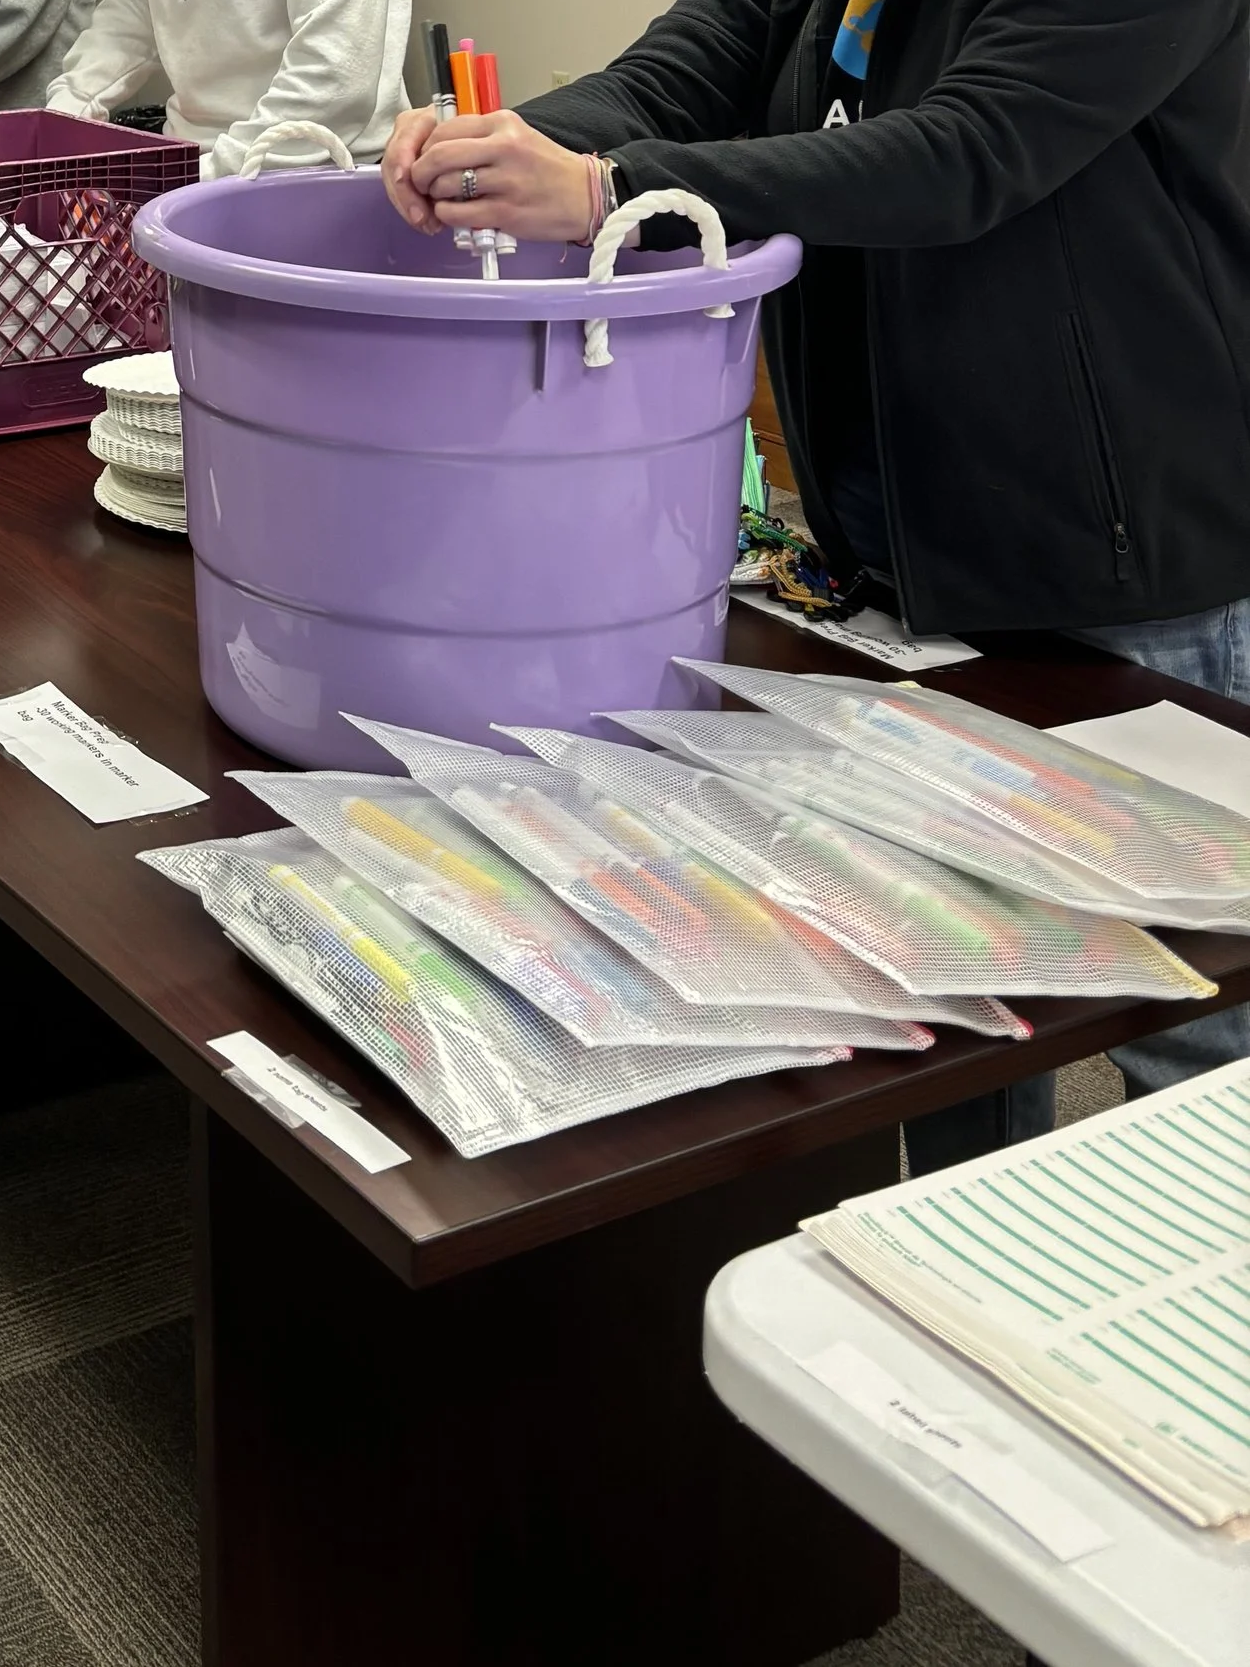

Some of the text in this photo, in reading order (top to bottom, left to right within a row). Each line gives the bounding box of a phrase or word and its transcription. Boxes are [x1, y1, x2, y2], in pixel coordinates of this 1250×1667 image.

[838, 634, 858, 644] Bag
[901, 639, 923, 653] bag
[858, 642, 894, 660] Marker
[17, 709, 34, 722] bag
[51, 700, 109, 745] Marker Bag Prep
[46, 715, 76, 734] working
[72, 732, 104, 759] markers
[100, 758, 112, 767] in
[108, 764, 139, 787] marker
